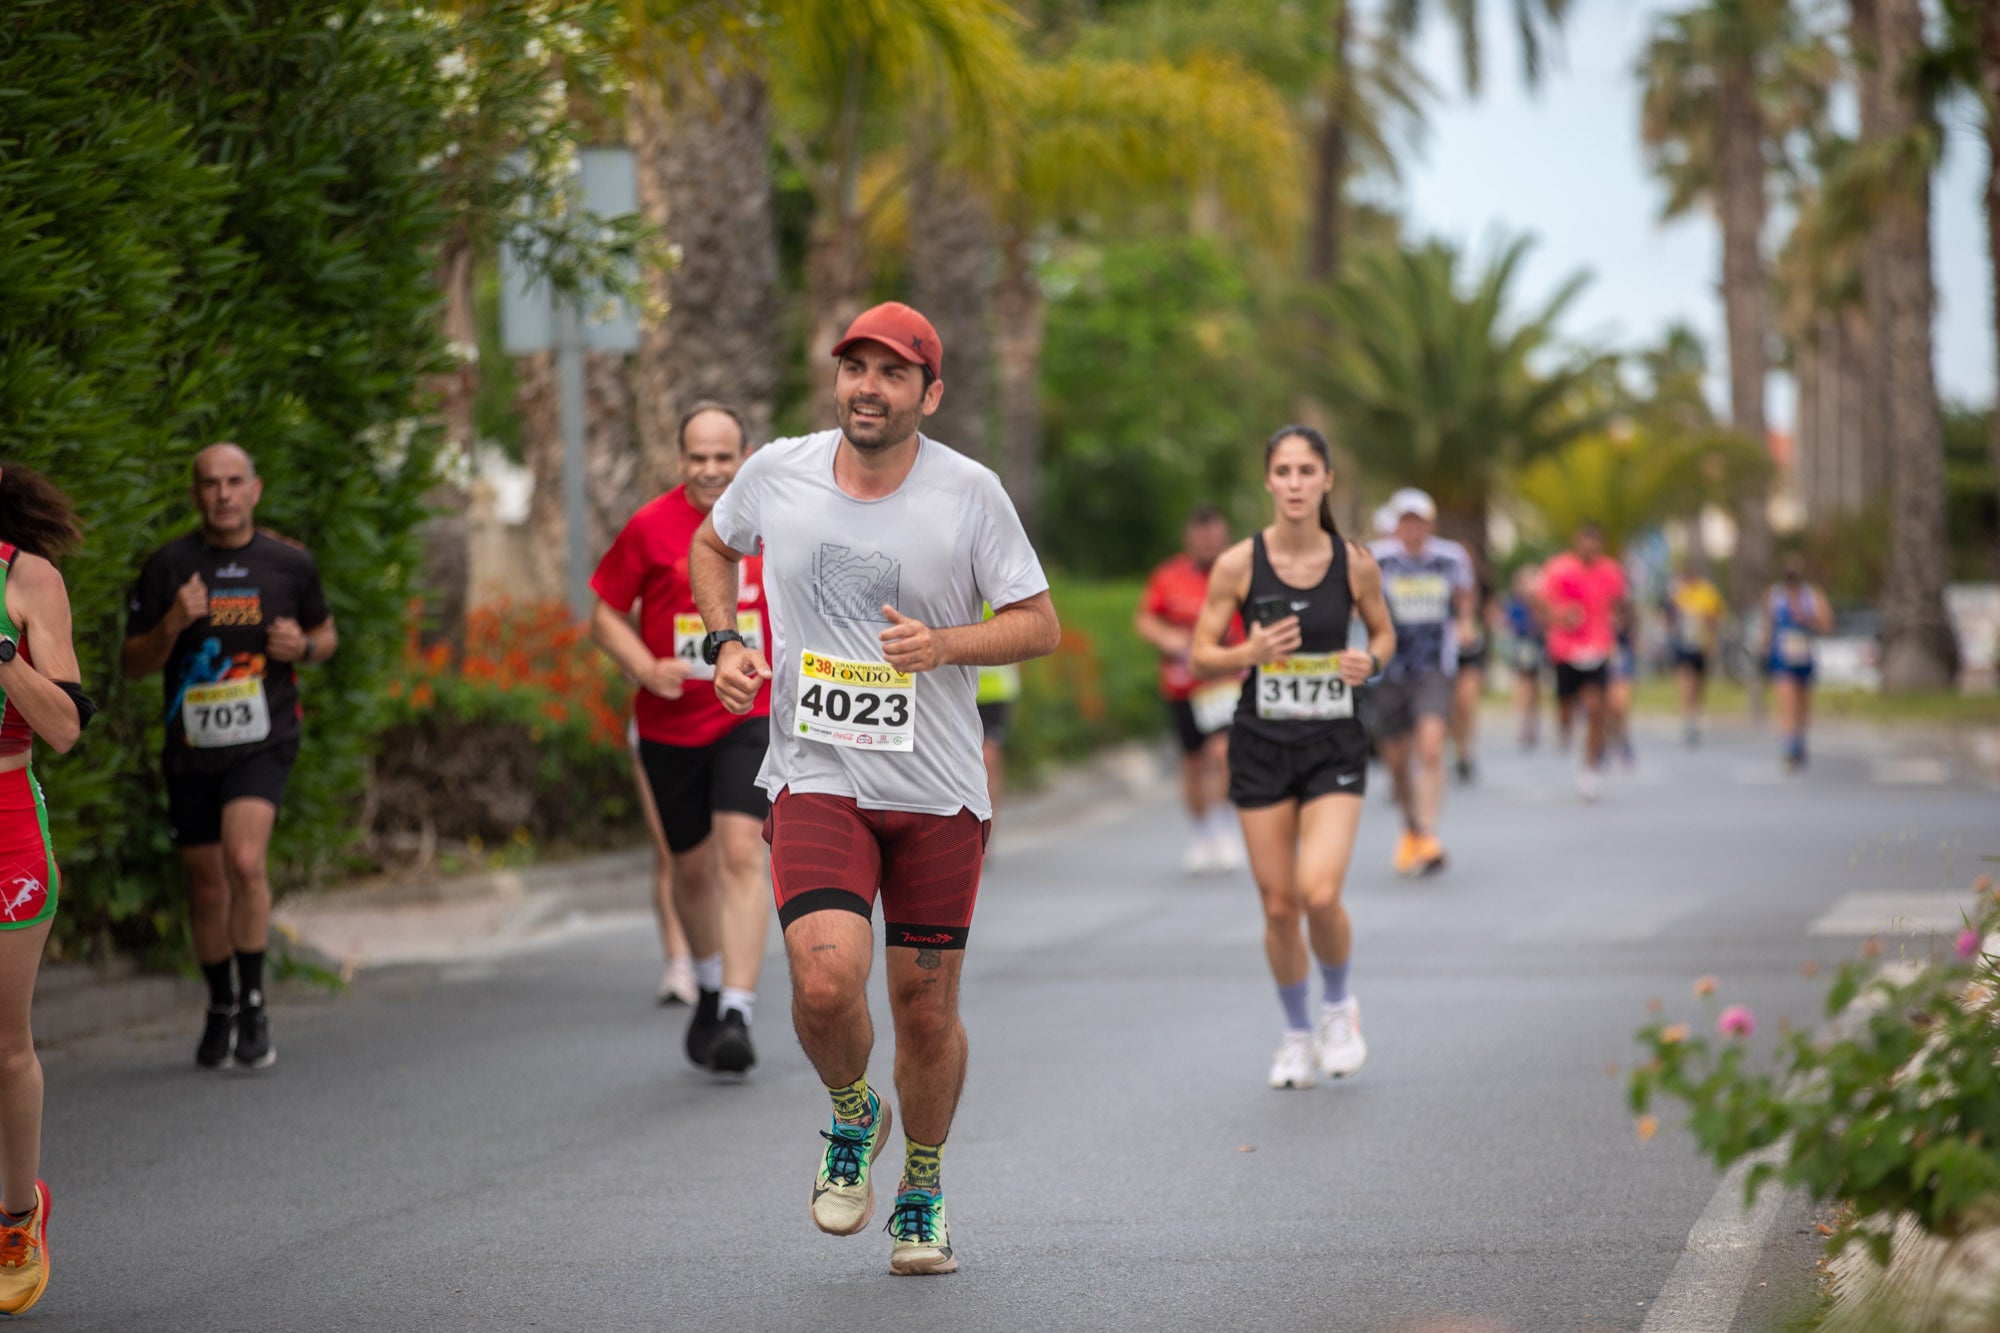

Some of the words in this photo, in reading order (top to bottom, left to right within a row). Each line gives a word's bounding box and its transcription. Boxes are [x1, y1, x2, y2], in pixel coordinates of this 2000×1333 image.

[815, 658, 832, 676] 38
[831, 666, 891, 683] FONDO
[835, 661, 856, 671] GRAN
[1264, 678, 1344, 702] 3179
[801, 684, 909, 727] 4023
[196, 702, 254, 731] 703
